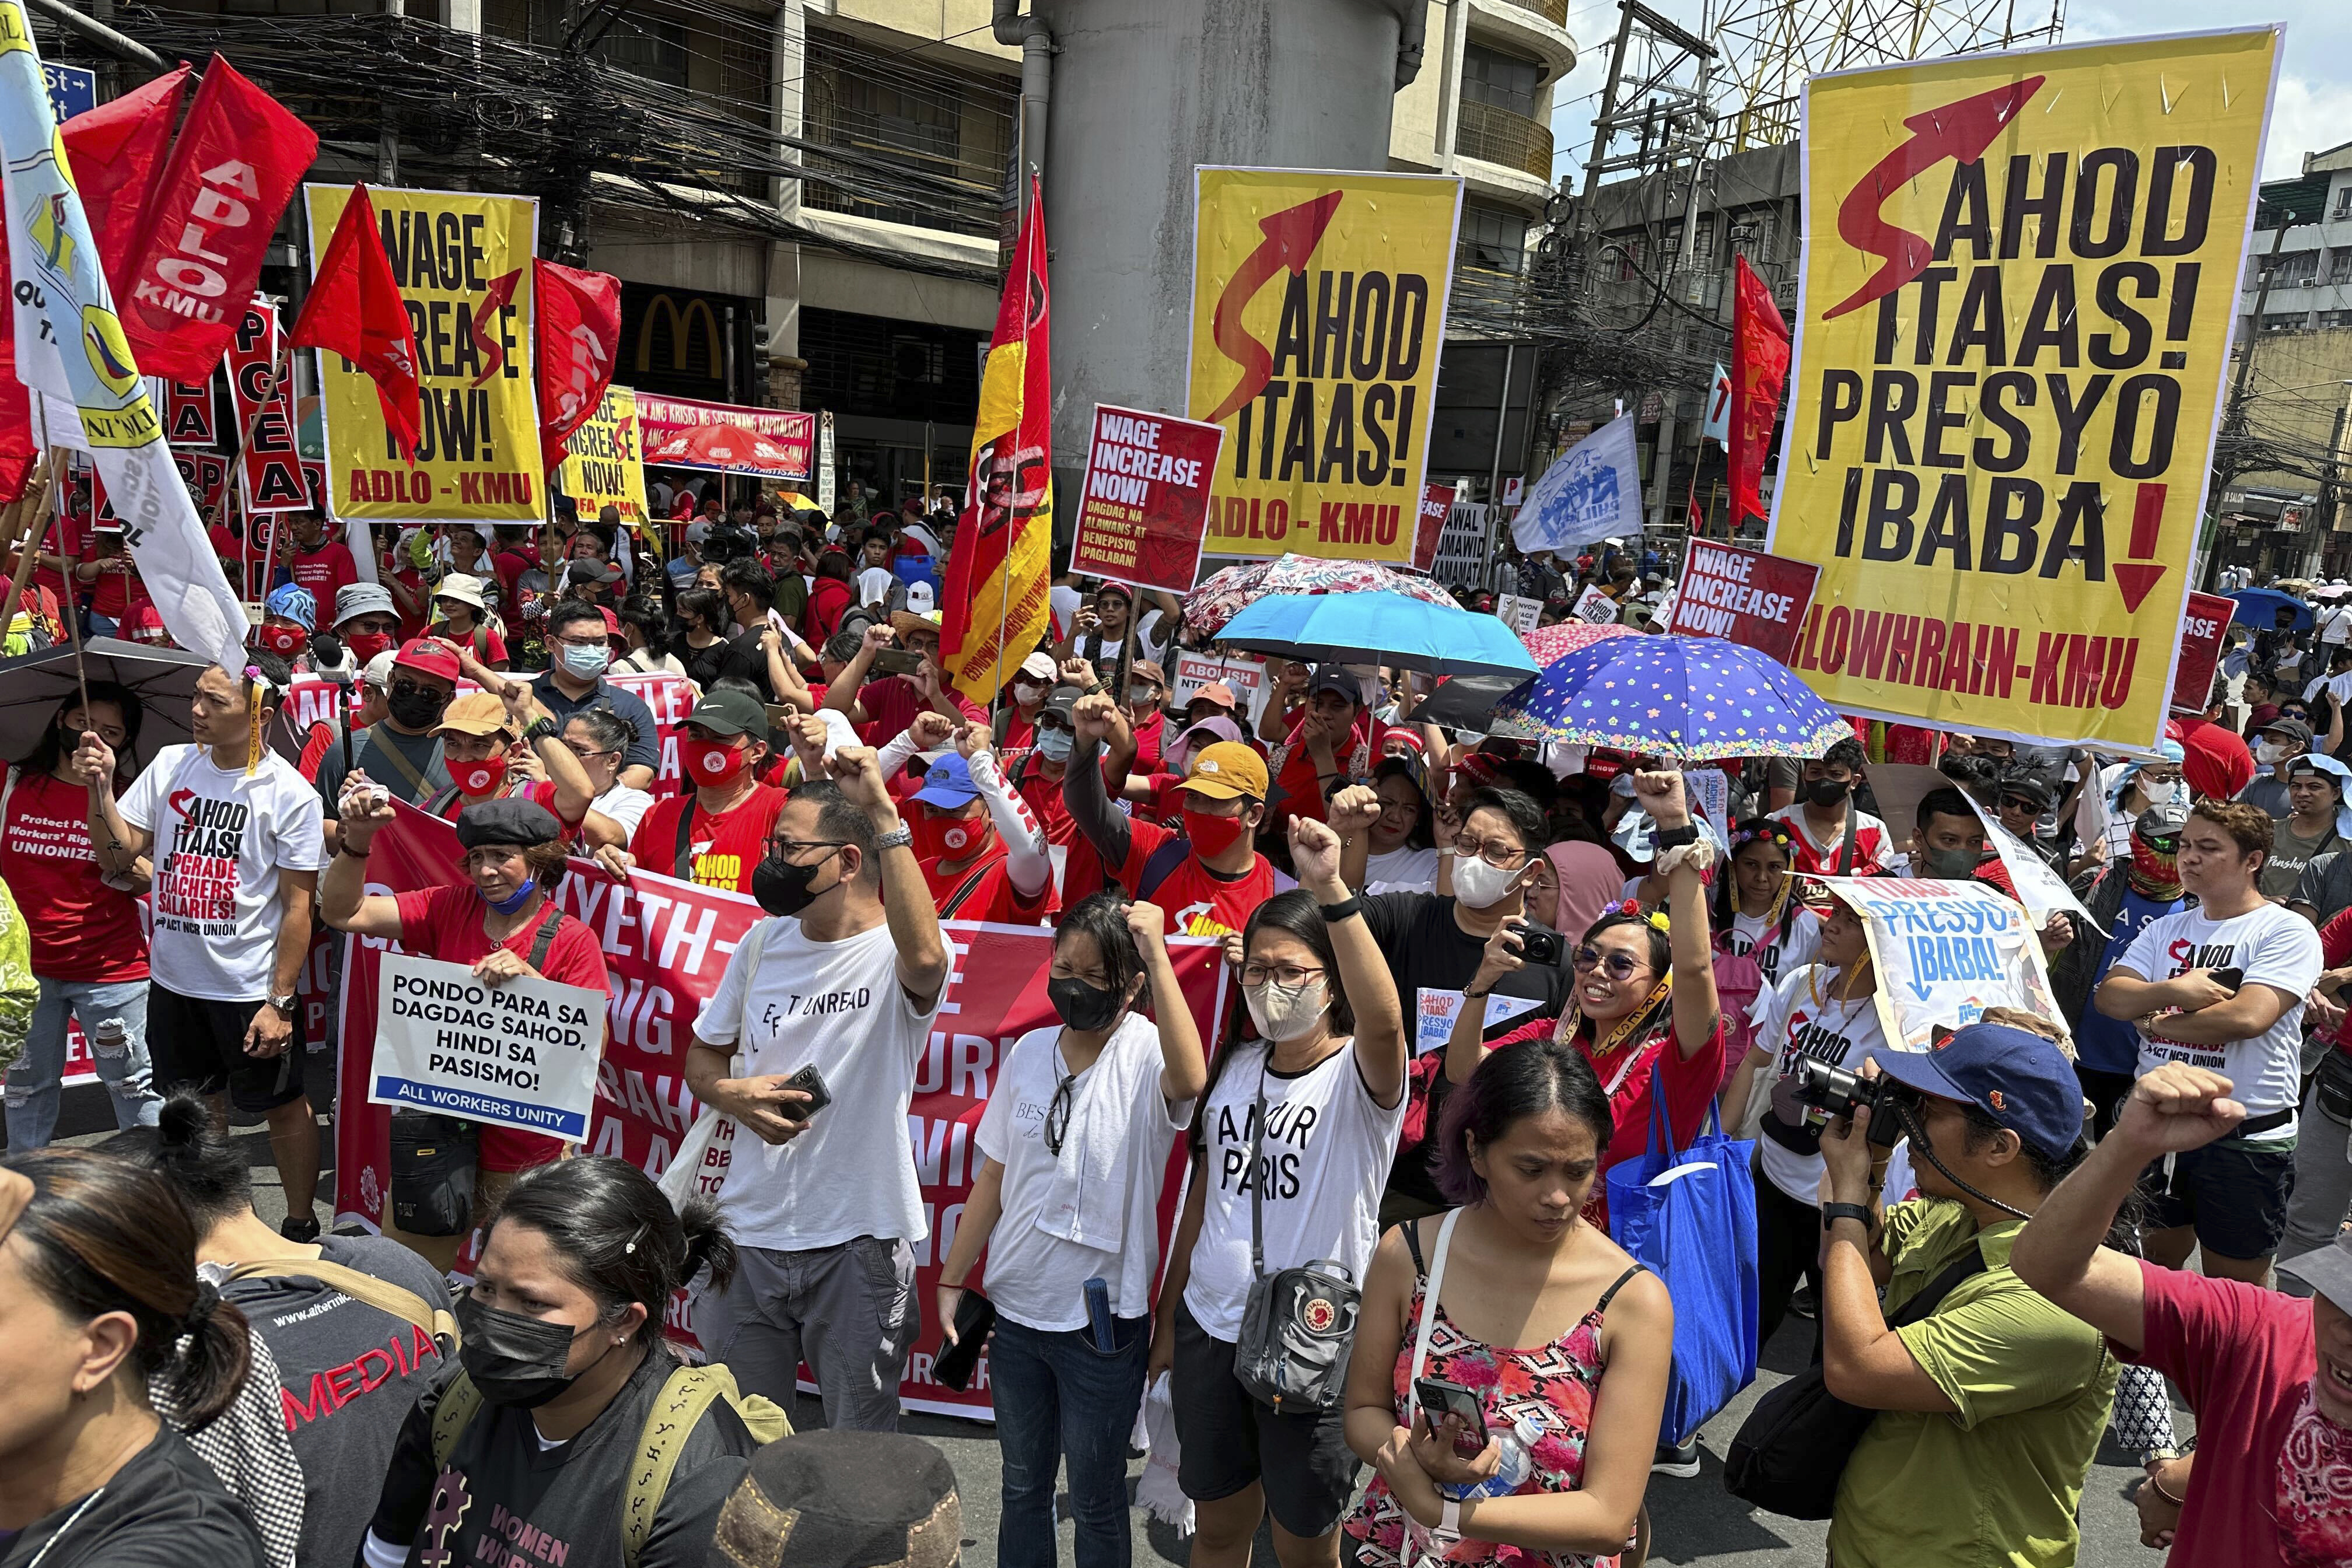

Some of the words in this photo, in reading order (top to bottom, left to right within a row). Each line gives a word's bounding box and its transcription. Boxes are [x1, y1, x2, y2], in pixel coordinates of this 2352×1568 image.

[134, 279, 224, 324] KMU
[1875, 262, 2200, 369] ITAAS!
[387, 387, 493, 463] OW!
[669, 403, 696, 426] KRISIS
[699, 408, 710, 426] NG
[1101, 413, 1162, 450] WAGE
[1815, 369, 2181, 480] PRESYO
[1234, 380, 1416, 487] ITAAS!
[581, 460, 625, 496] NOW!
[821, 478, 834, 487] RIGHT
[1094, 442, 1202, 488] INCREASE
[349, 469, 432, 503] ADLO
[461, 471, 533, 506] KMU
[1090, 471, 1149, 508] NOW!
[1084, 516, 1131, 536] ALAWANS
[1134, 527, 1147, 539] AT
[1087, 500, 1125, 519] DAGDAG
[1128, 508, 1143, 523] NA
[1317, 502, 1401, 545] KMU
[1080, 545, 1137, 568] IPAGLABAN!
[1082, 530, 1138, 554] BENEPISYO,
[1693, 545, 1755, 584] WAGE
[1518, 603, 1538, 611] NYON
[1685, 572, 1794, 625] INCREASE
[1677, 600, 1737, 639] NOW!
[249, 701, 258, 770] PRESYO
[1709, 775, 1718, 810] TEACHER
[20, 813, 69, 829] Protect
[72, 819, 88, 830] Pu
[67, 834, 92, 845] Rig
[174, 823, 243, 860] ITAAS!
[163, 850, 239, 880] UPGRADE
[158, 895, 236, 920] SALARIES!
[1866, 900, 2007, 937] PRESYO
[166, 919, 181, 932] ACT
[183, 921, 200, 936] NCR
[203, 923, 237, 936] UNION
[393, 974, 484, 1005] PONDO
[491, 990, 550, 1020] PARA
[556, 1003, 589, 1027] SA
[803, 987, 870, 1016] UNREAD
[391, 998, 495, 1030] DAGDAG
[502, 1016, 586, 1051] SAHOD,
[436, 1030, 501, 1058] HINDI
[508, 1042, 537, 1067] SA
[2168, 1049, 2189, 1065] NCR
[2192, 1053, 2226, 1069] UNION
[428, 1052, 540, 1091] PASISMO!
[397, 1083, 426, 1102] ALL
[431, 1089, 512, 1118] WORKERS
[515, 1105, 566, 1127] UNITY
[1220, 1148, 1300, 1201] PARIS
[489, 1503, 570, 1567] WOMEN
